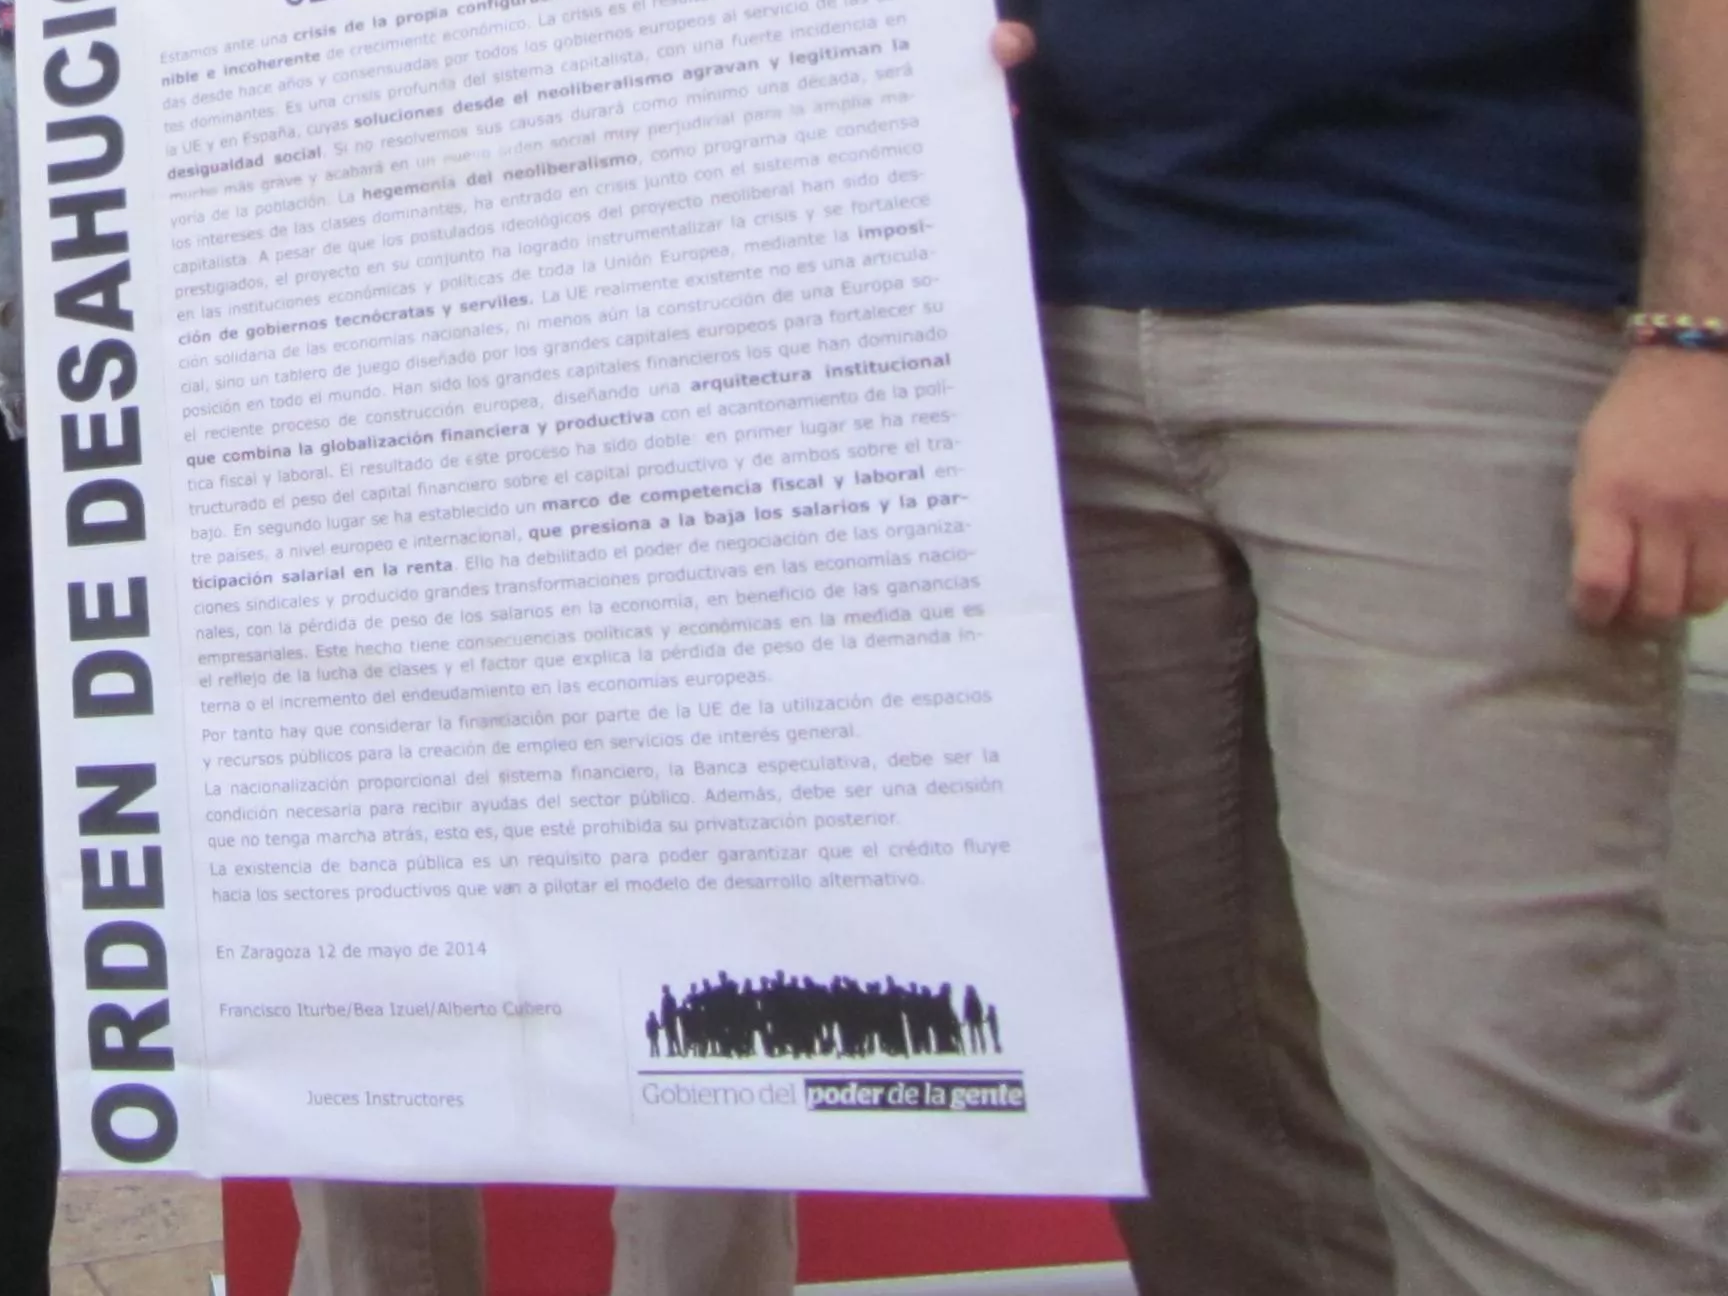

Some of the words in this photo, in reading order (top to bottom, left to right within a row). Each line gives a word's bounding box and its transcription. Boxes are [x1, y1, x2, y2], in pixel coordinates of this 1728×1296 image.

[159, 44, 218, 64] Estamos
[223, 38, 256, 53] ante
[260, 32, 288, 47] una
[292, 24, 337, 41] crisis
[343, 19, 365, 32] de
[371, 15, 388, 28] la
[394, 7, 449, 27] propia
[160, 70, 201, 86] nible
[205, 68, 217, 79] e
[221, 51, 322, 75] incoherente
[353, 106, 444, 128] soluciones
[452, 95, 505, 113] desde
[512, 89, 528, 104] el
[536, 72, 674, 99] neoliberalismo
[682, 59, 759, 81] agravan
[768, 57, 779, 70] y
[788, 43, 882, 65] legitiman
[891, 38, 910, 52] la
[166, 153, 265, 179] desigualdad
[361, 176, 456, 200] hegemonía
[465, 170, 493, 186] del
[177, 329, 212, 345] ción
[218, 327, 238, 341] de
[244, 318, 328, 340] gobiernos
[334, 305, 435, 327] tecnócratas
[441, 304, 452, 318] y
[690, 369, 812, 392] arquitectura
[824, 352, 951, 377] institucional
[185, 453, 216, 468] que
[221, 445, 292, 463] combina
[298, 442, 314, 455] la
[320, 431, 434, 456] globalización
[440, 423, 530, 441] financiera
[536, 422, 547, 436] y
[554, 411, 654, 434] productiva
[541, 496, 600, 511] marco
[607, 491, 631, 505] de
[639, 480, 763, 502] competencia
[770, 473, 824, 491] fiscal
[832, 475, 844, 489] y
[853, 464, 925, 484] laboral
[528, 525, 562, 541] que
[570, 518, 651, 538] presiona
[659, 516, 670, 529] a
[678, 512, 696, 526] la
[703, 509, 746, 526] baja
[753, 506, 783, 520] los
[791, 499, 870, 517] salarios
[878, 499, 890, 514] y
[898, 494, 918, 508] la
[191, 571, 273, 590] ticipación
[281, 565, 345, 583] salarial
[352, 566, 374, 578] en
[382, 562, 398, 576] la
[67, 576, 154, 719] DE
[209, 861, 226, 876] La
[234, 860, 312, 875] existencia
[320, 858, 339, 873] de
[349, 858, 397, 872] banca
[406, 854, 463, 873] pública
[472, 856, 490, 868] es
[500, 854, 518, 868] un
[528, 850, 601, 868] requisito
[610, 851, 648, 867] para
[658, 846, 708, 866] poder
[718, 846, 806, 865] garantizar
[818, 845, 852, 862] que
[862, 841, 877, 858] el
[889, 840, 953, 857] crédito
[963, 837, 1010, 856] fluye
[212, 887, 251, 902] hacia
[256, 887, 278, 901] los
[283, 886, 350, 900] sectores
[355, 883, 451, 901] productivos
[456, 883, 487, 898] que
[492, 882, 521, 895] van
[527, 881, 537, 894] a
[543, 878, 597, 896] pilotar
[604, 877, 619, 892] el
[624, 876, 690, 892] modelo
[696, 875, 717, 890] de
[723, 873, 812, 890] desarrollo
[75, 762, 179, 1165] ORDEN
[216, 944, 234, 959] En
[240, 944, 311, 962] Zaragoza
[318, 942, 336, 960] 12
[341, 943, 361, 958] de
[367, 945, 412, 960] mayo
[418, 941, 438, 957] de
[445, 940, 486, 956] 2014
[219, 1002, 290, 1018] Francisco
[297, 1002, 383, 1017] Iturbe/Bea
[390, 1001, 496, 1017] Izuel/Alberto
[502, 998, 562, 1016] Cubero
[306, 1090, 358, 1105] Jueces
[366, 1090, 463, 1107] Instructores
[642, 1082, 756, 1106] Gobierno
[758, 1082, 796, 1106] del
[809, 1082, 885, 1109] poder
[887, 1081, 919, 1105] de
[924, 1082, 946, 1105] la
[950, 1083, 1024, 1111] gente
